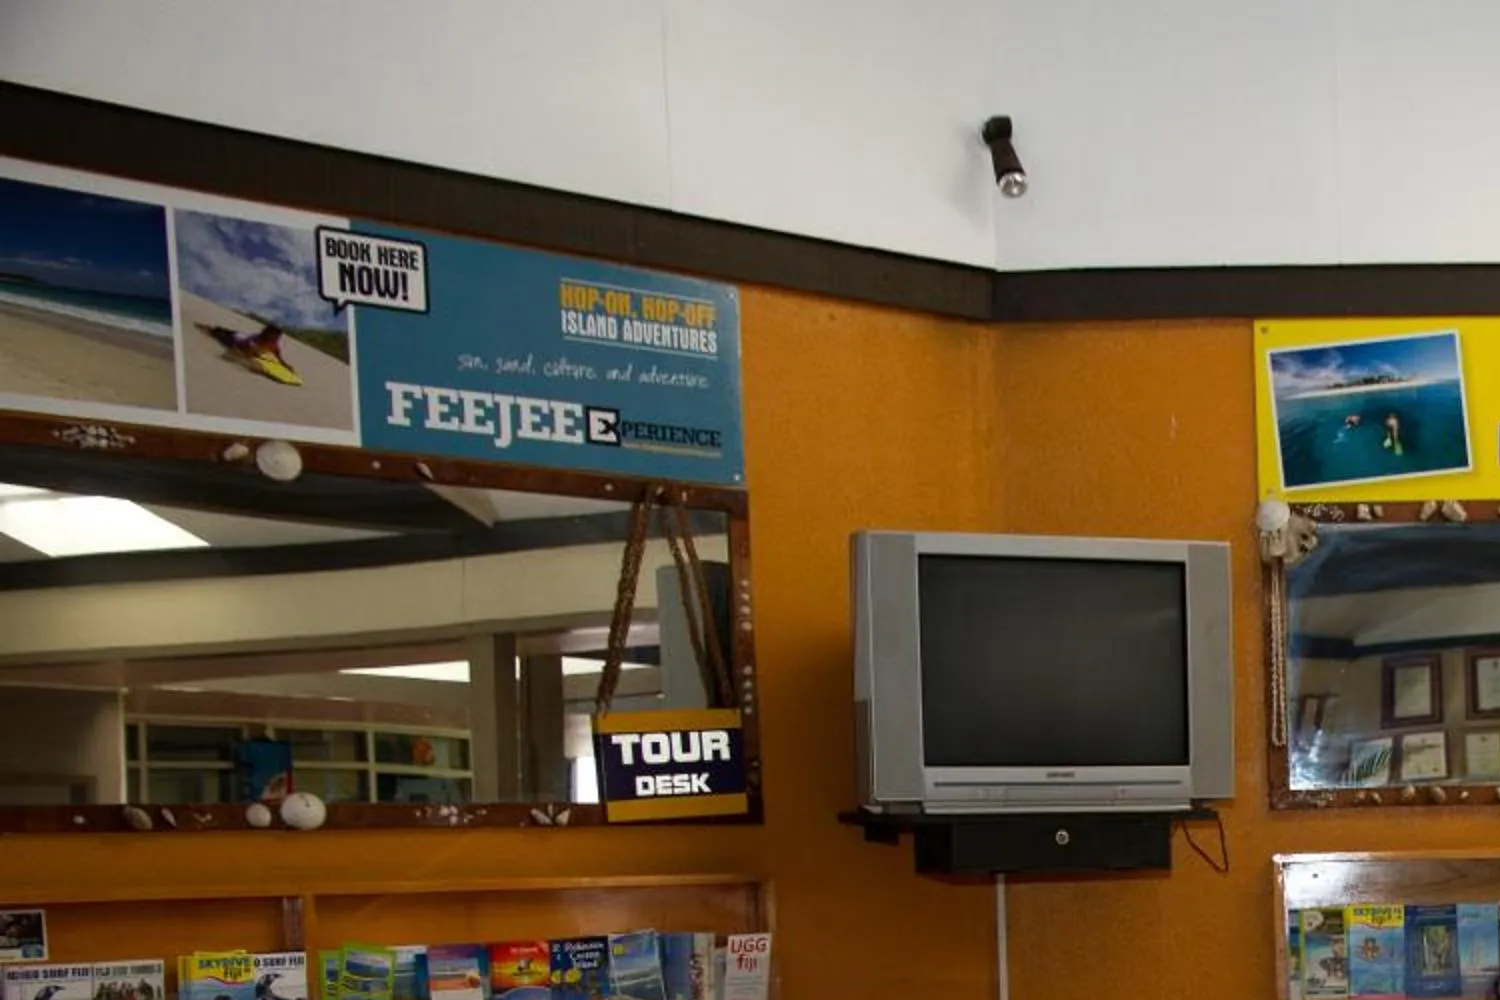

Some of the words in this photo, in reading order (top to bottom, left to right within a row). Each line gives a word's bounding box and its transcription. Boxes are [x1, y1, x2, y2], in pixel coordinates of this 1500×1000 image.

[325, 237, 371, 262] BOOK
[377, 245, 419, 271] HERE
[339, 262, 408, 302] NOW!
[641, 295, 717, 327] HOP-OFF
[561, 309, 618, 340] ISLAND
[623, 318, 718, 352] ADVENTURES
[385, 381, 586, 449] FEEJEE
[611, 730, 731, 765] TOUR
[635, 772, 712, 797] DESK
[730, 938, 767, 953] UGG
